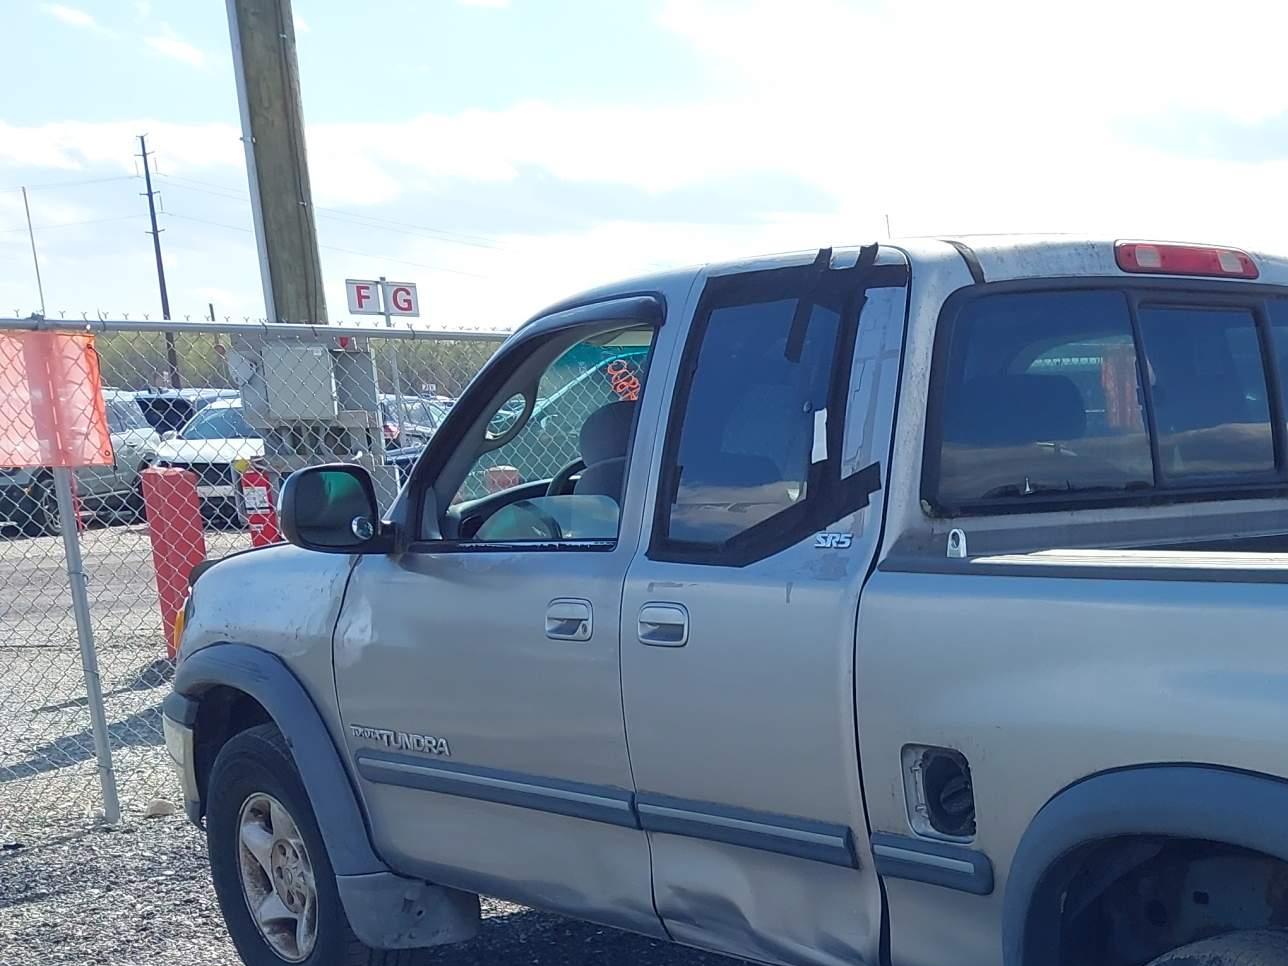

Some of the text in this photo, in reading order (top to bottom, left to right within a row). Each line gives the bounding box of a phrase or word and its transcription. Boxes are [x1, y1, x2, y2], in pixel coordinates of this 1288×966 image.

[356, 285, 371, 309] F
[392, 287, 413, 312] G
[814, 533, 853, 549] SR5
[379, 729, 451, 757] TUNDRA
